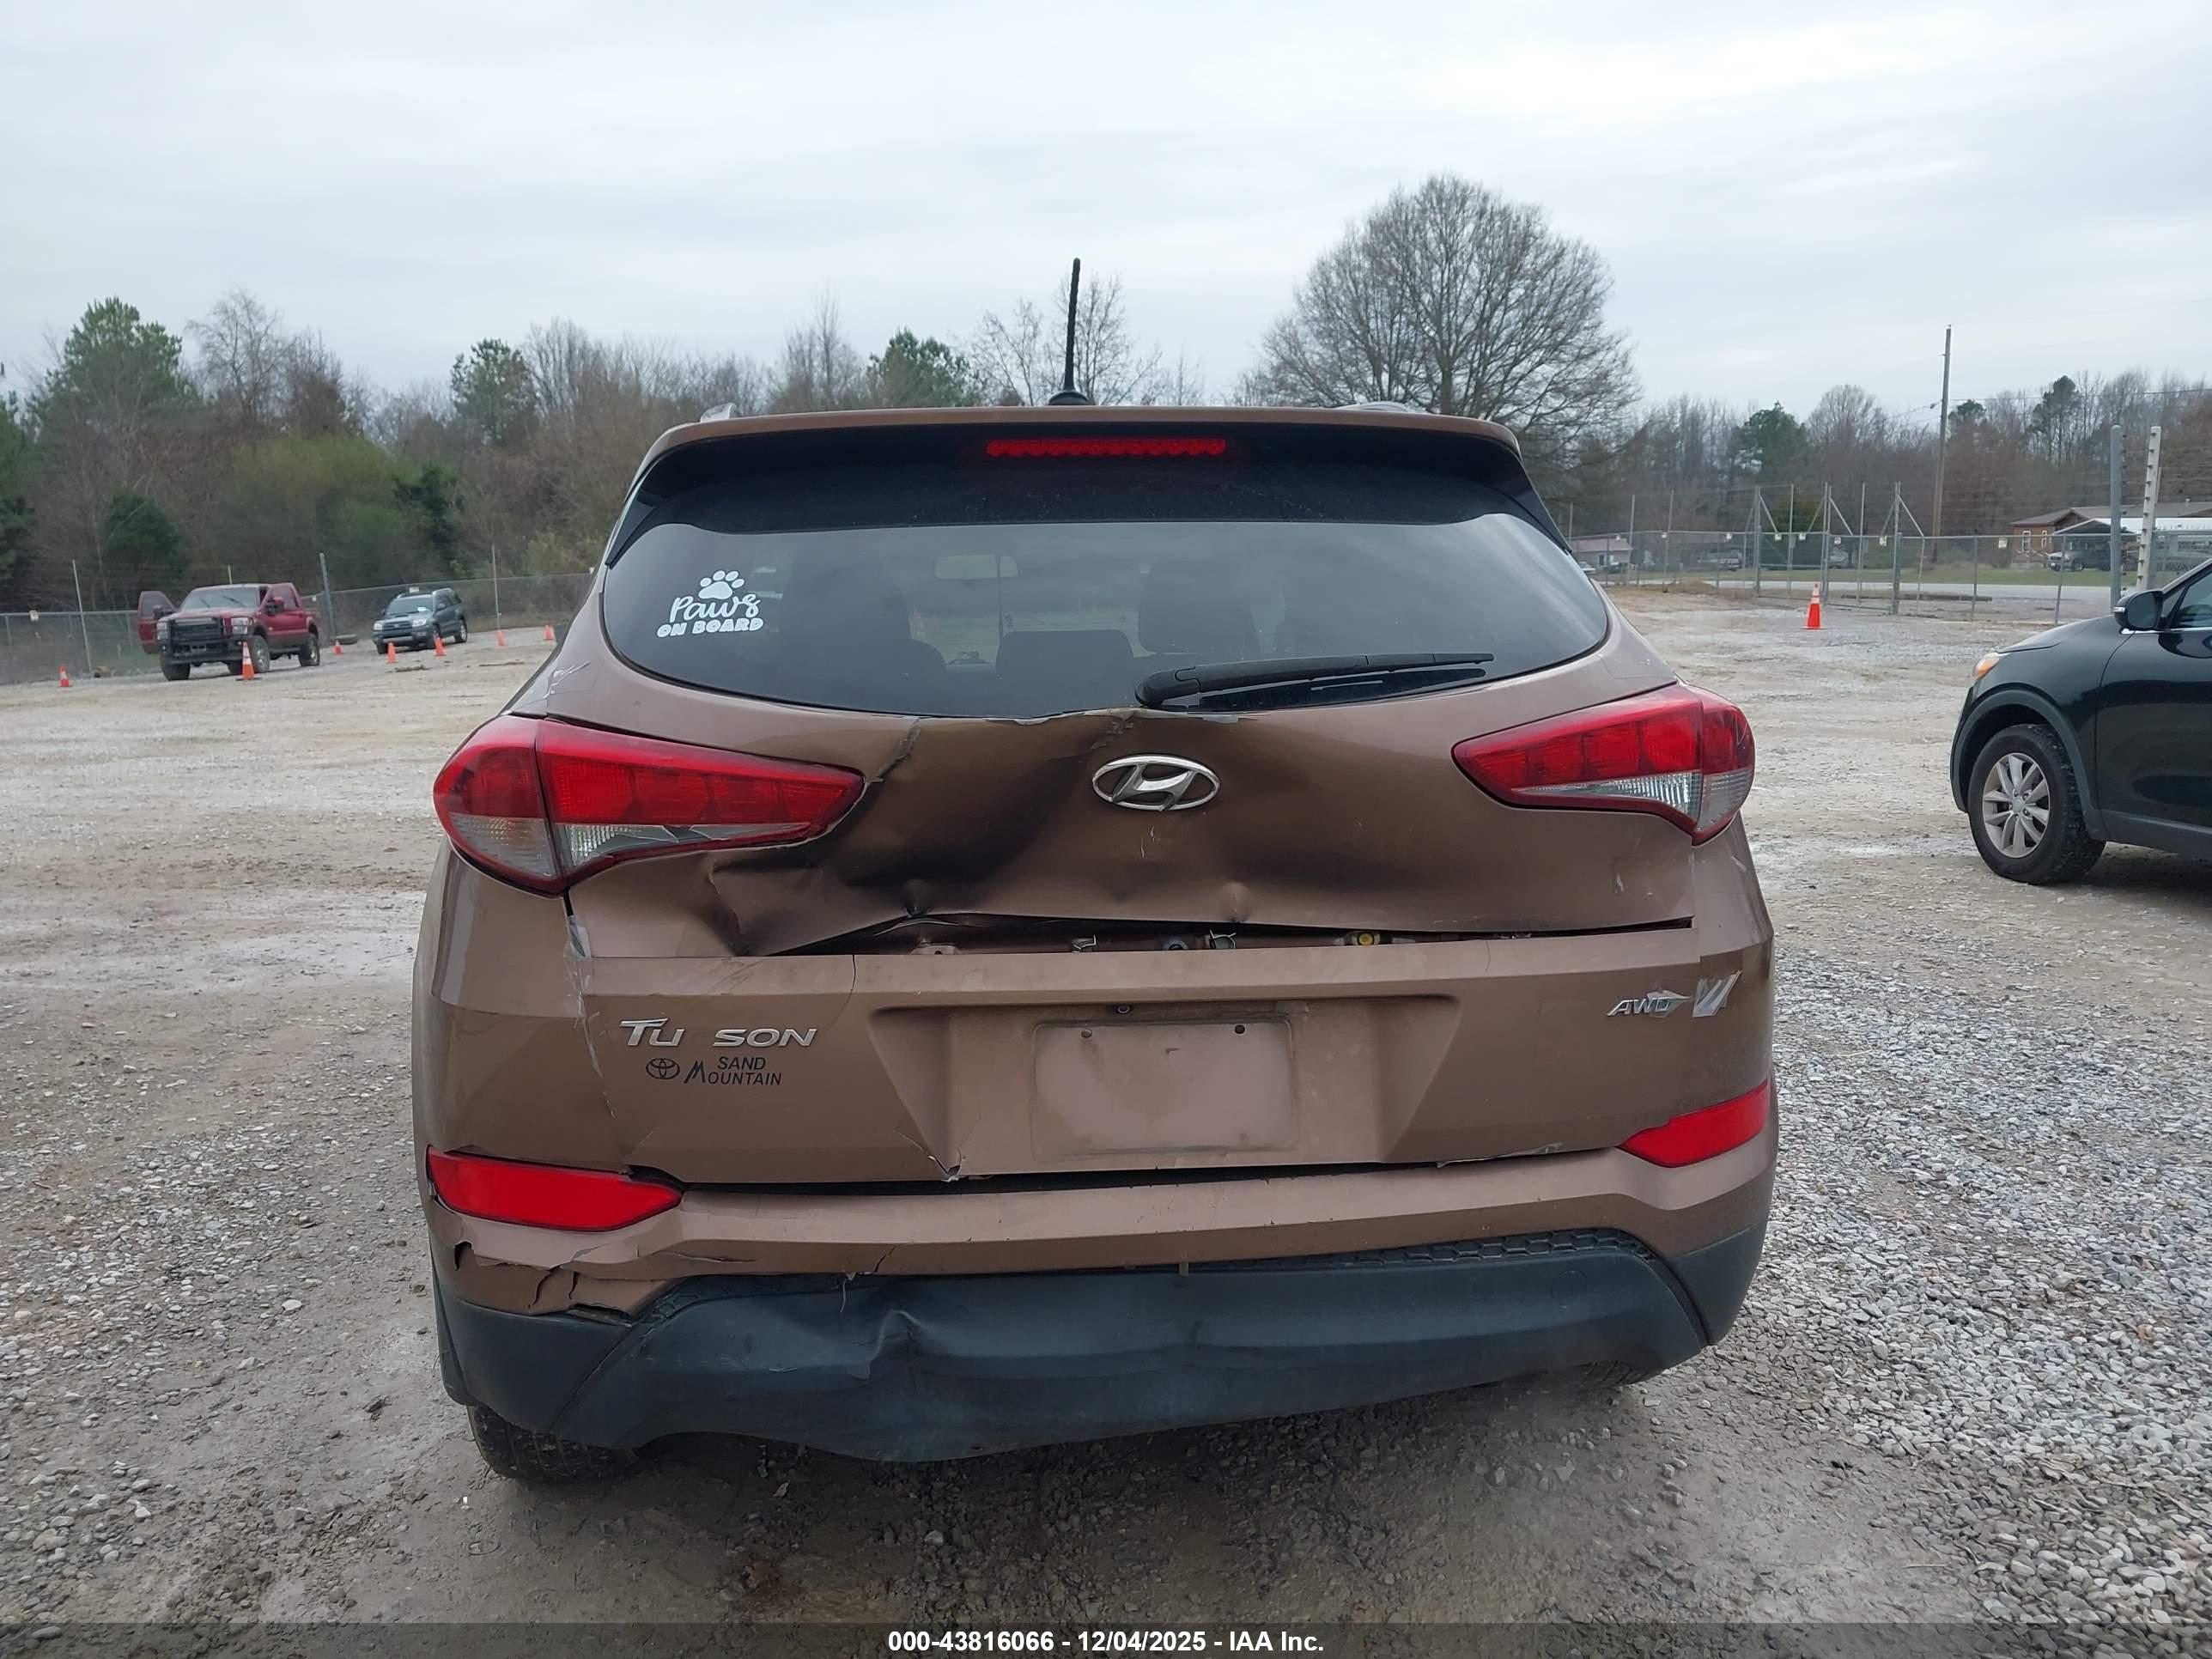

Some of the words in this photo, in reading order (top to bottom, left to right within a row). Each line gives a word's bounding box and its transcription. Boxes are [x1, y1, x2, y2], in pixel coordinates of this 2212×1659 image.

[670, 593, 761, 623] Paws
[657, 623, 687, 637] ON
[692, 617, 763, 634] BOARD
[1607, 998, 1671, 1016] AWD
[717, 1056, 766, 1071] SAND
